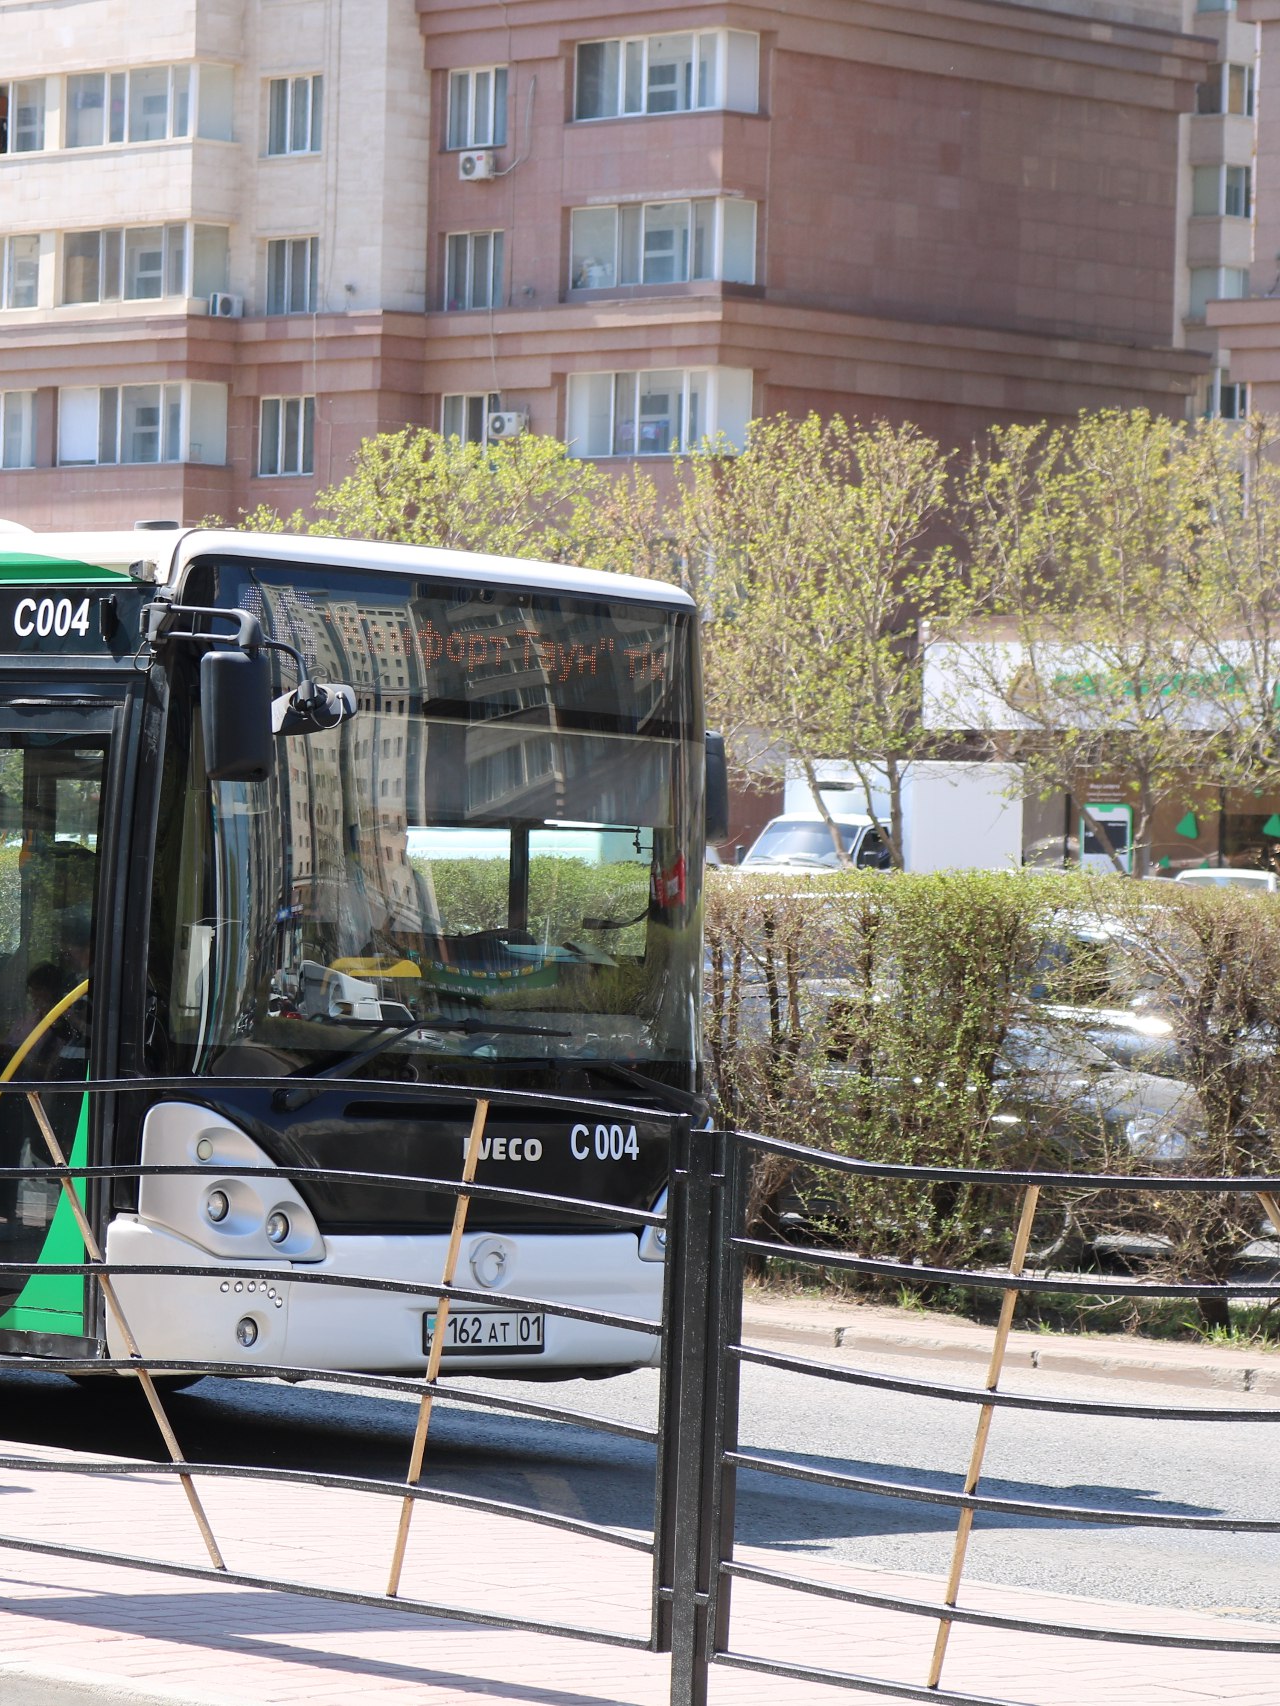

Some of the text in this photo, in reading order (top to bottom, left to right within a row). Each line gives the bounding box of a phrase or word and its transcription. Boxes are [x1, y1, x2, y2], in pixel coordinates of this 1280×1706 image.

[14, 598, 91, 637] C004
[448, 1315, 541, 1344] 162 AT 01
